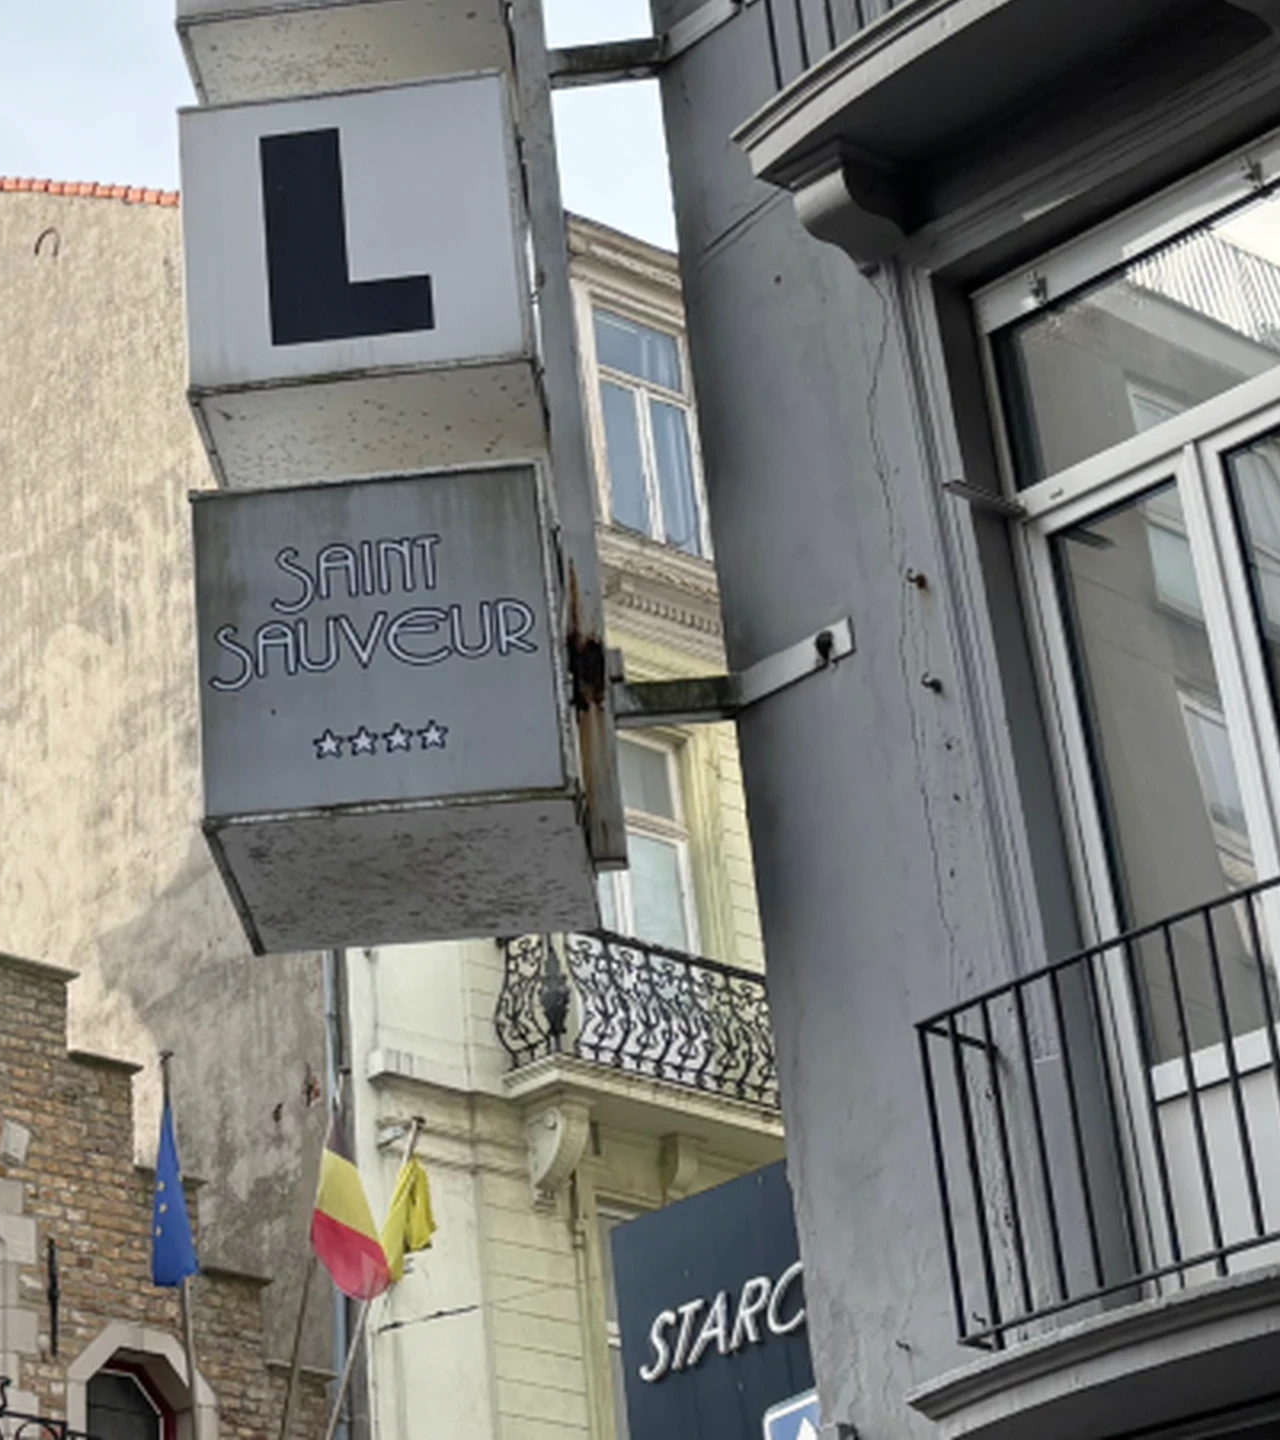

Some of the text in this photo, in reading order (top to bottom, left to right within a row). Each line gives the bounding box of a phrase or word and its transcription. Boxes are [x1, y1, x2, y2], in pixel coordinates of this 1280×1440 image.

[271, 534, 441, 615] SAINT
[209, 598, 538, 692] SAUVEUR
[639, 1260, 805, 1383] STARC
